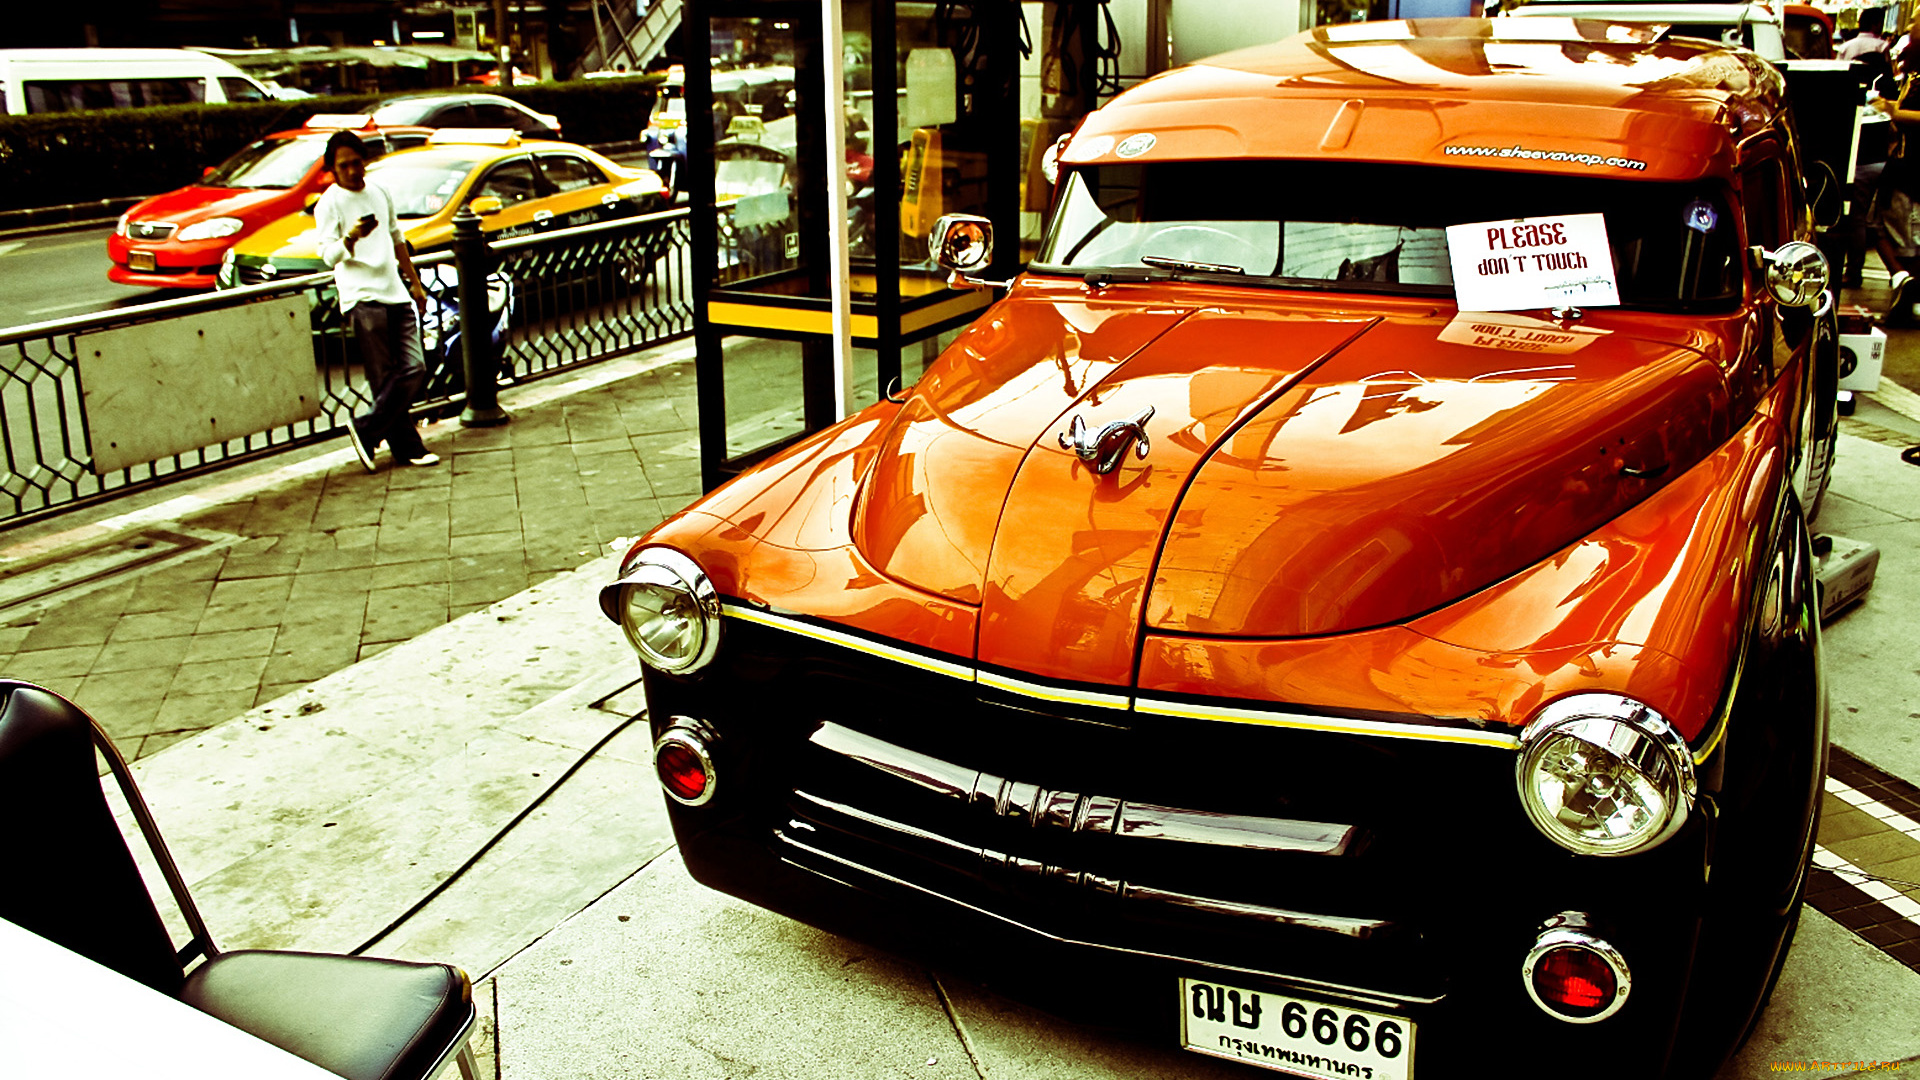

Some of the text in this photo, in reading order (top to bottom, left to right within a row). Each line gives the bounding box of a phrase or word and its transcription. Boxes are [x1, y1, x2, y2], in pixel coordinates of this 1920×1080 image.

[1444, 145, 1647, 171] www.sheevawop.com
[1281, 1001, 1403, 1059] 6666
[1218, 1035, 1374, 1080] กรุงเทพมหานคร
